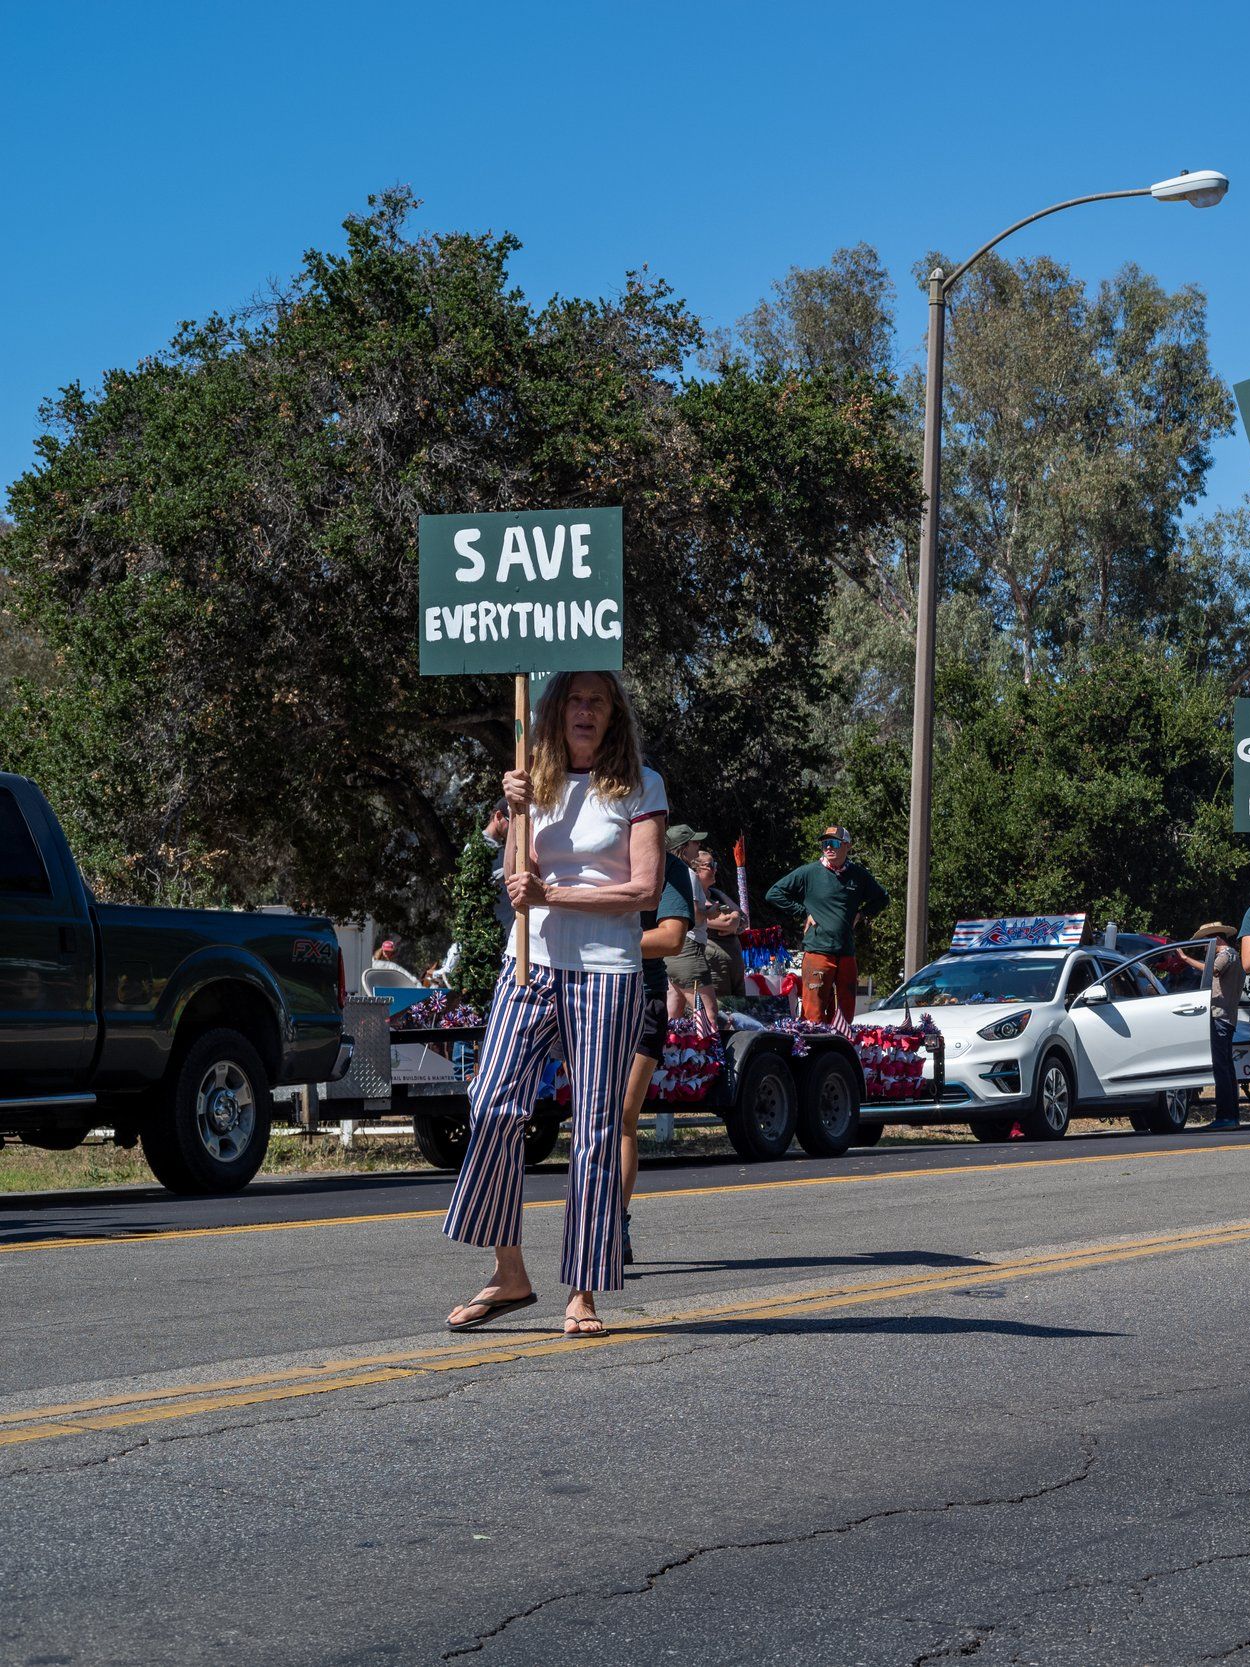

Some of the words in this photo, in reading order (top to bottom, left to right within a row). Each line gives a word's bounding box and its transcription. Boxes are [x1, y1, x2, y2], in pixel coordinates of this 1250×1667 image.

[454, 524, 592, 582] SAVE
[425, 599, 622, 643] EVERYTHING
[293, 939, 333, 957] FX4
